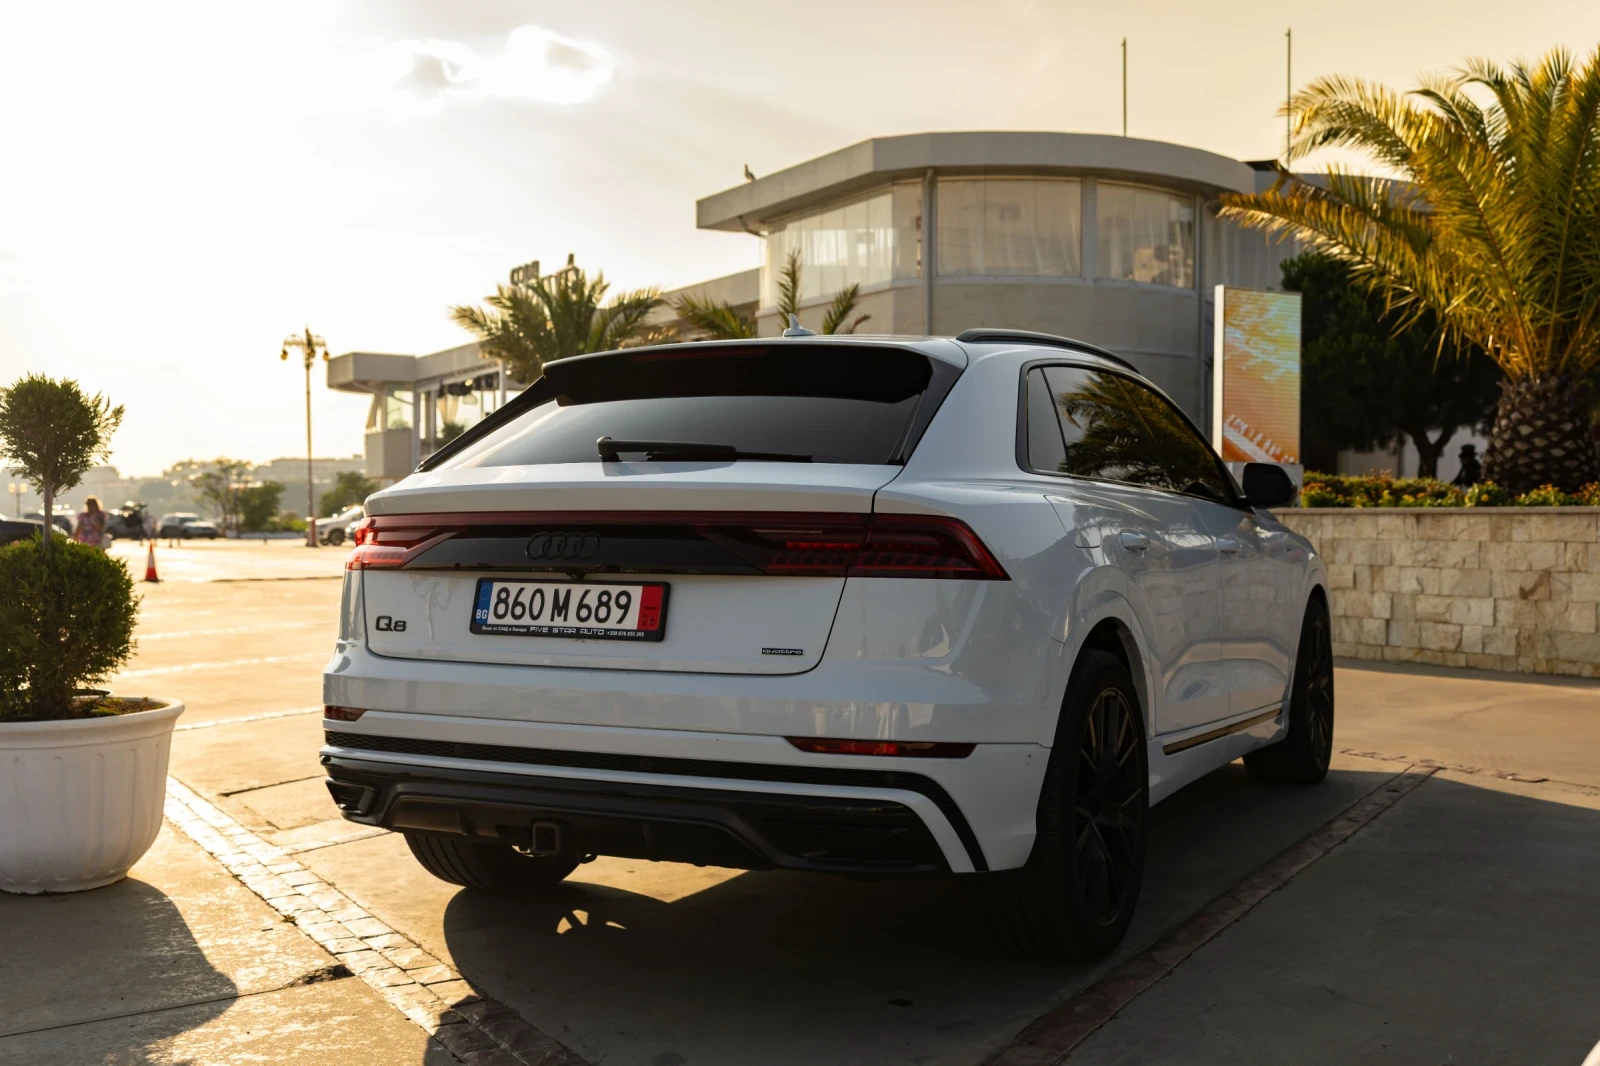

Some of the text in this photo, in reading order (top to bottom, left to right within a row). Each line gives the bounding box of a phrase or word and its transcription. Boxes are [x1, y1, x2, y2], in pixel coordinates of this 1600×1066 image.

[493, 586, 632, 625] 860 M 689
[476, 609, 488, 620] BG
[375, 615, 407, 632] Q8
